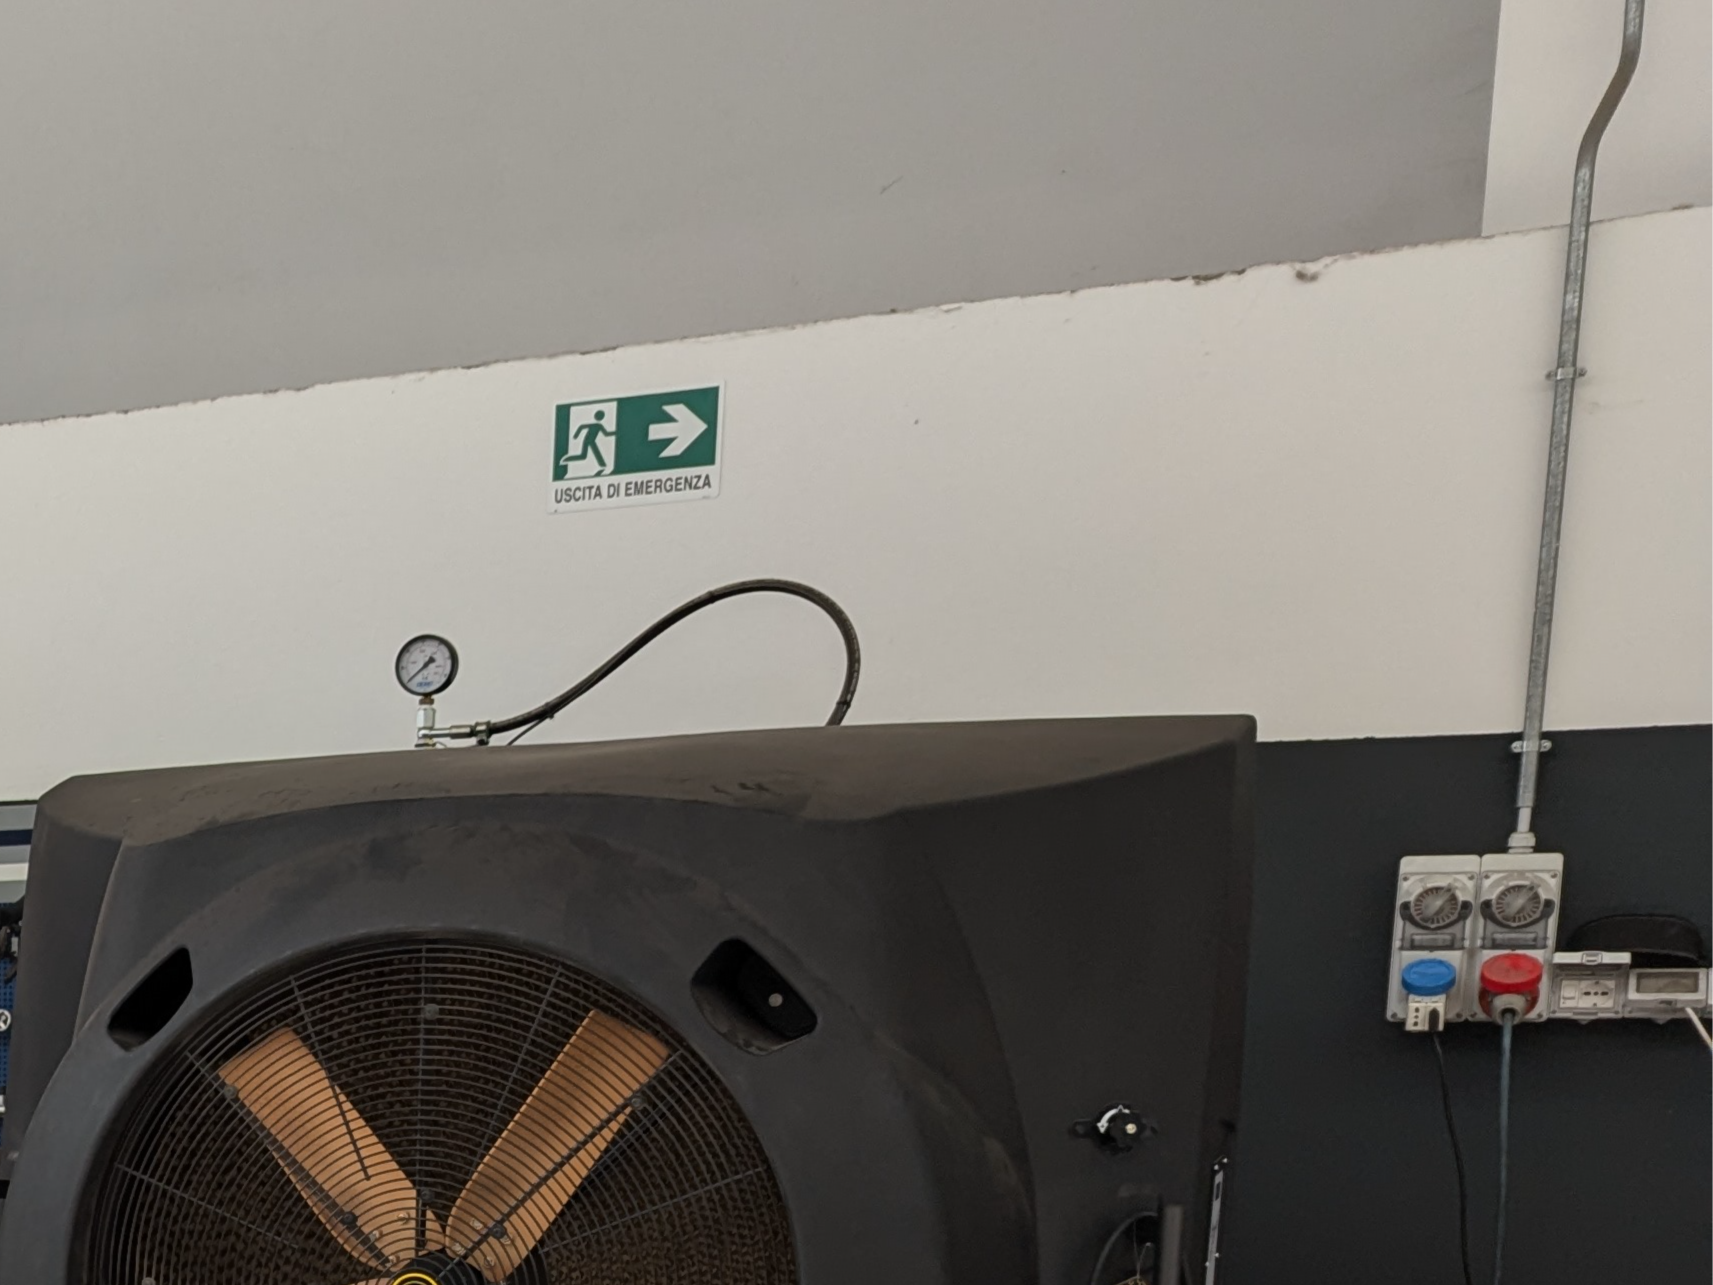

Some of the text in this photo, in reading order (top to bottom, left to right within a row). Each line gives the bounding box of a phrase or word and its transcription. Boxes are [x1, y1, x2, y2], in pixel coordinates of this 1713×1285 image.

[554, 473, 712, 504] USCITA DI EMERGENZA
